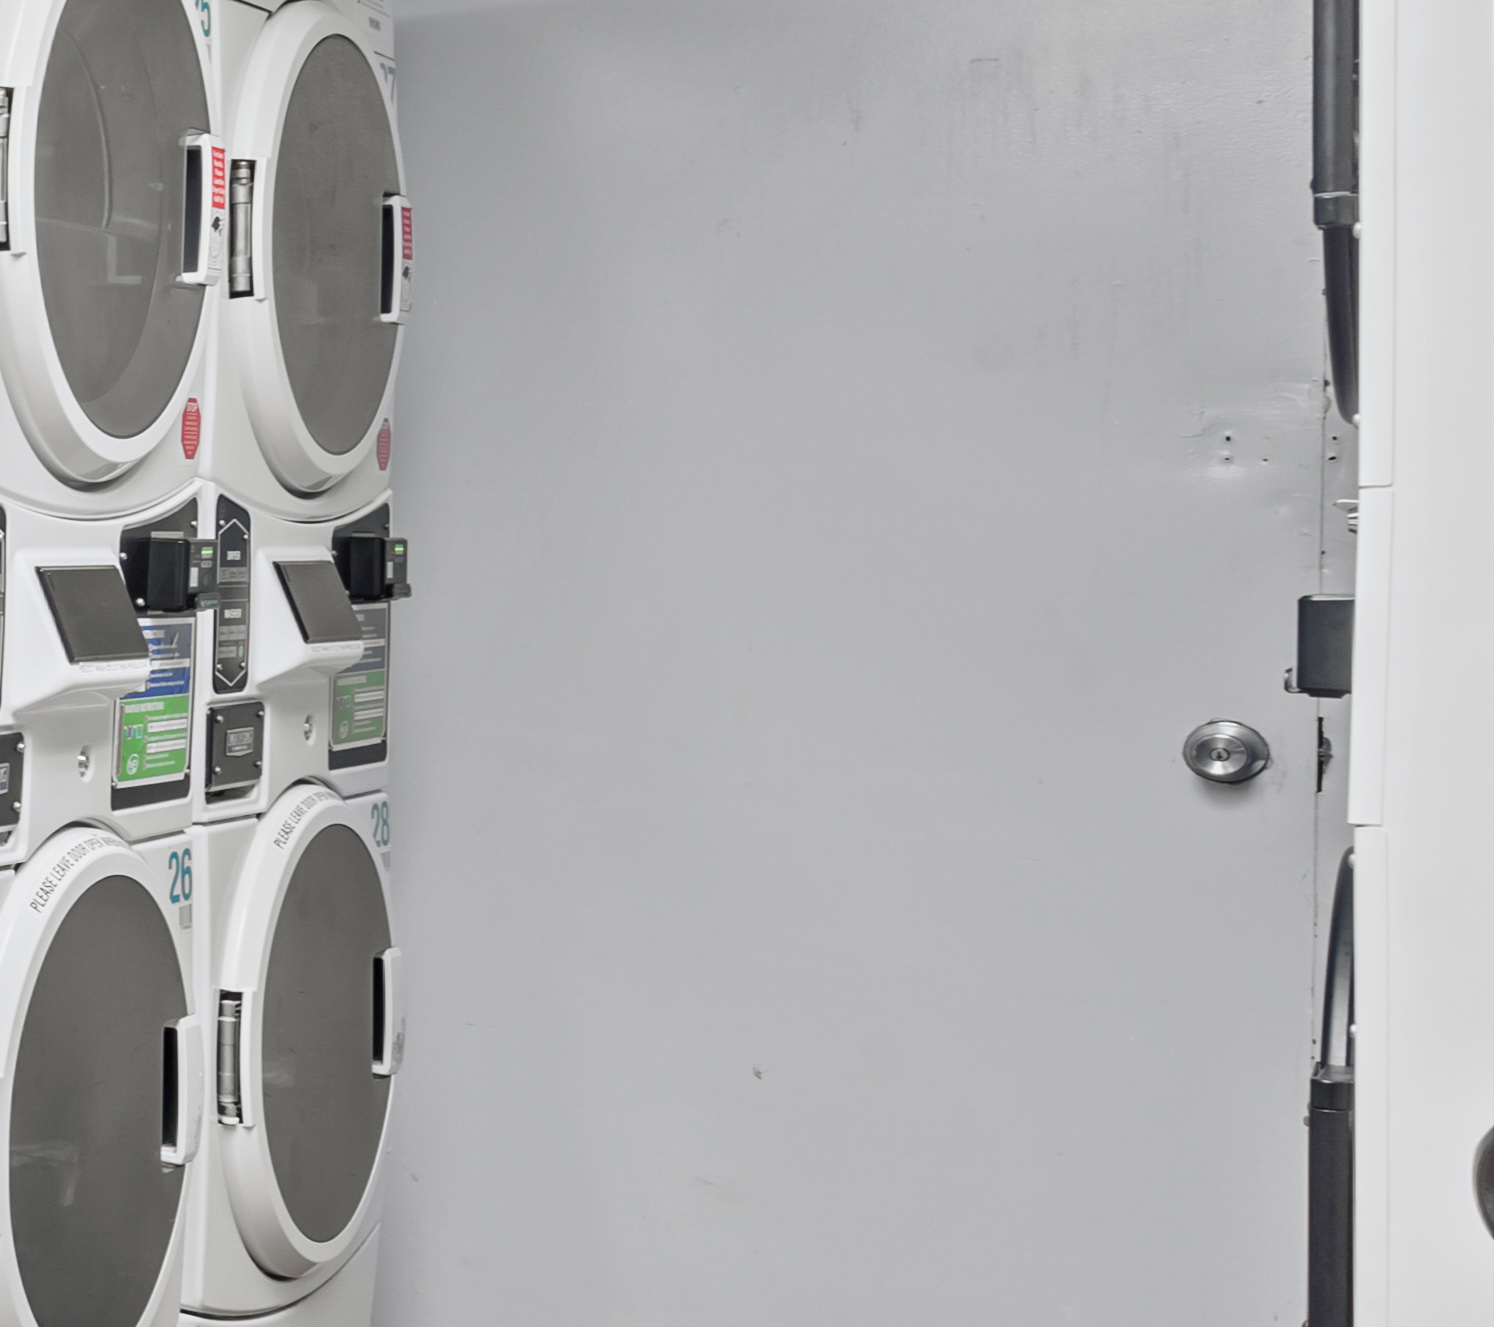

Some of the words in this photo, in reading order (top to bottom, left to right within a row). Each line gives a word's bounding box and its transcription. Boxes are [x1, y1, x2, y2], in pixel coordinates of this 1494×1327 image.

[371, 801, 390, 848] 28
[29, 876, 57, 913] PLEASE
[50, 856, 75, 882] LEAVE
[67, 843, 87, 863] DOOR
[168, 848, 192, 904] 26
